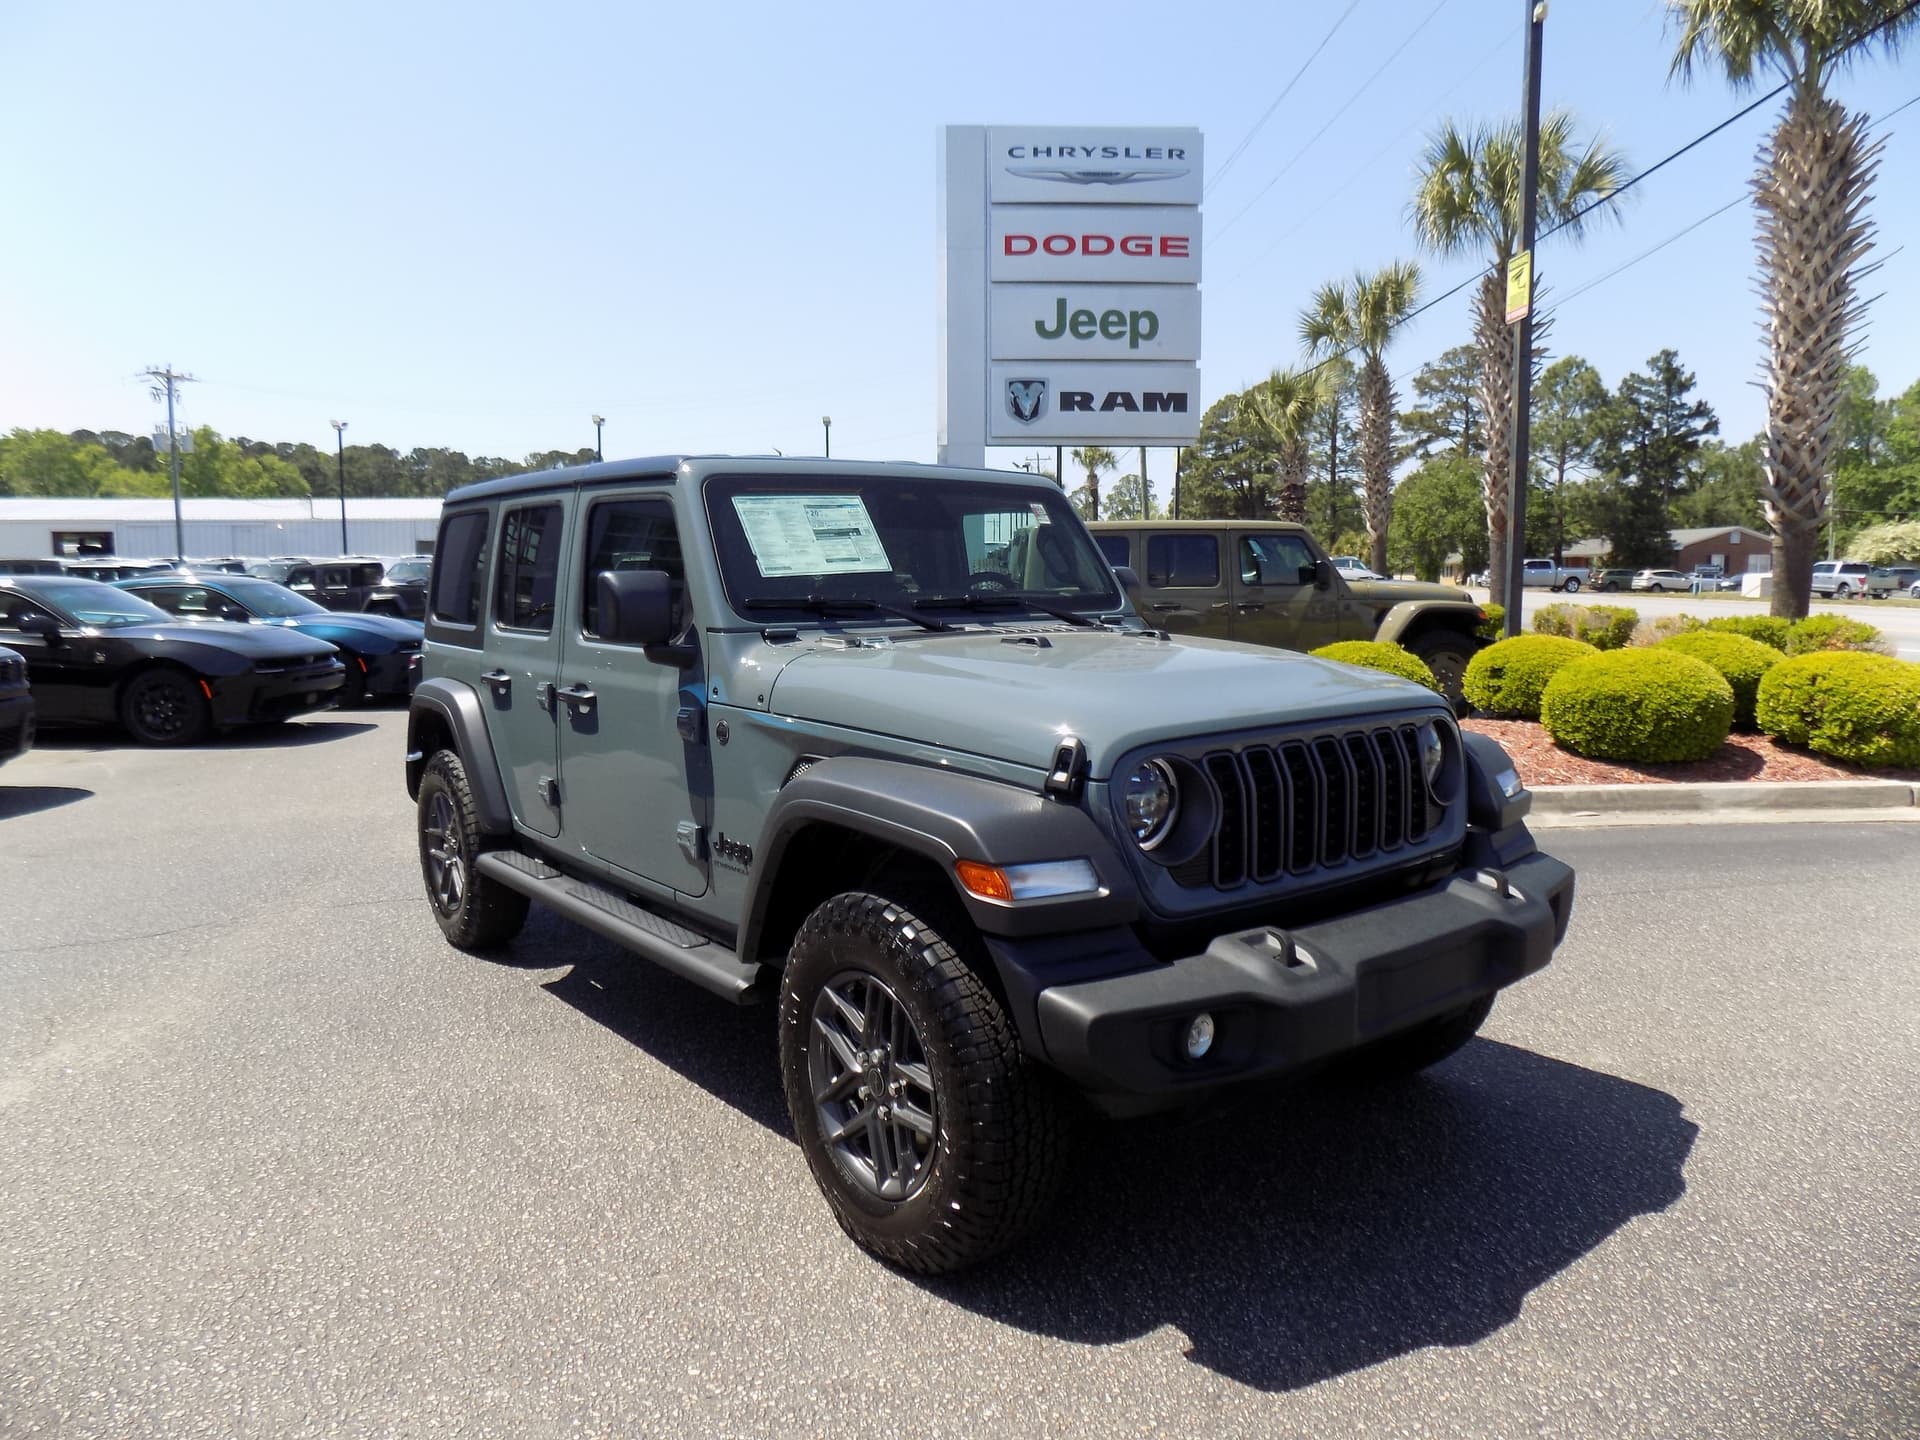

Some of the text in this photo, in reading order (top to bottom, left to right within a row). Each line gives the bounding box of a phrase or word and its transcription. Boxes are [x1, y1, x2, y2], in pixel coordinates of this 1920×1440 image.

[1008, 146, 1186, 160] CHRYSLER
[1004, 235, 1189, 257] DODGE
[1035, 298, 1159, 349] Jeep
[1059, 392, 1188, 412] RAM
[713, 832, 753, 865] Jeep
